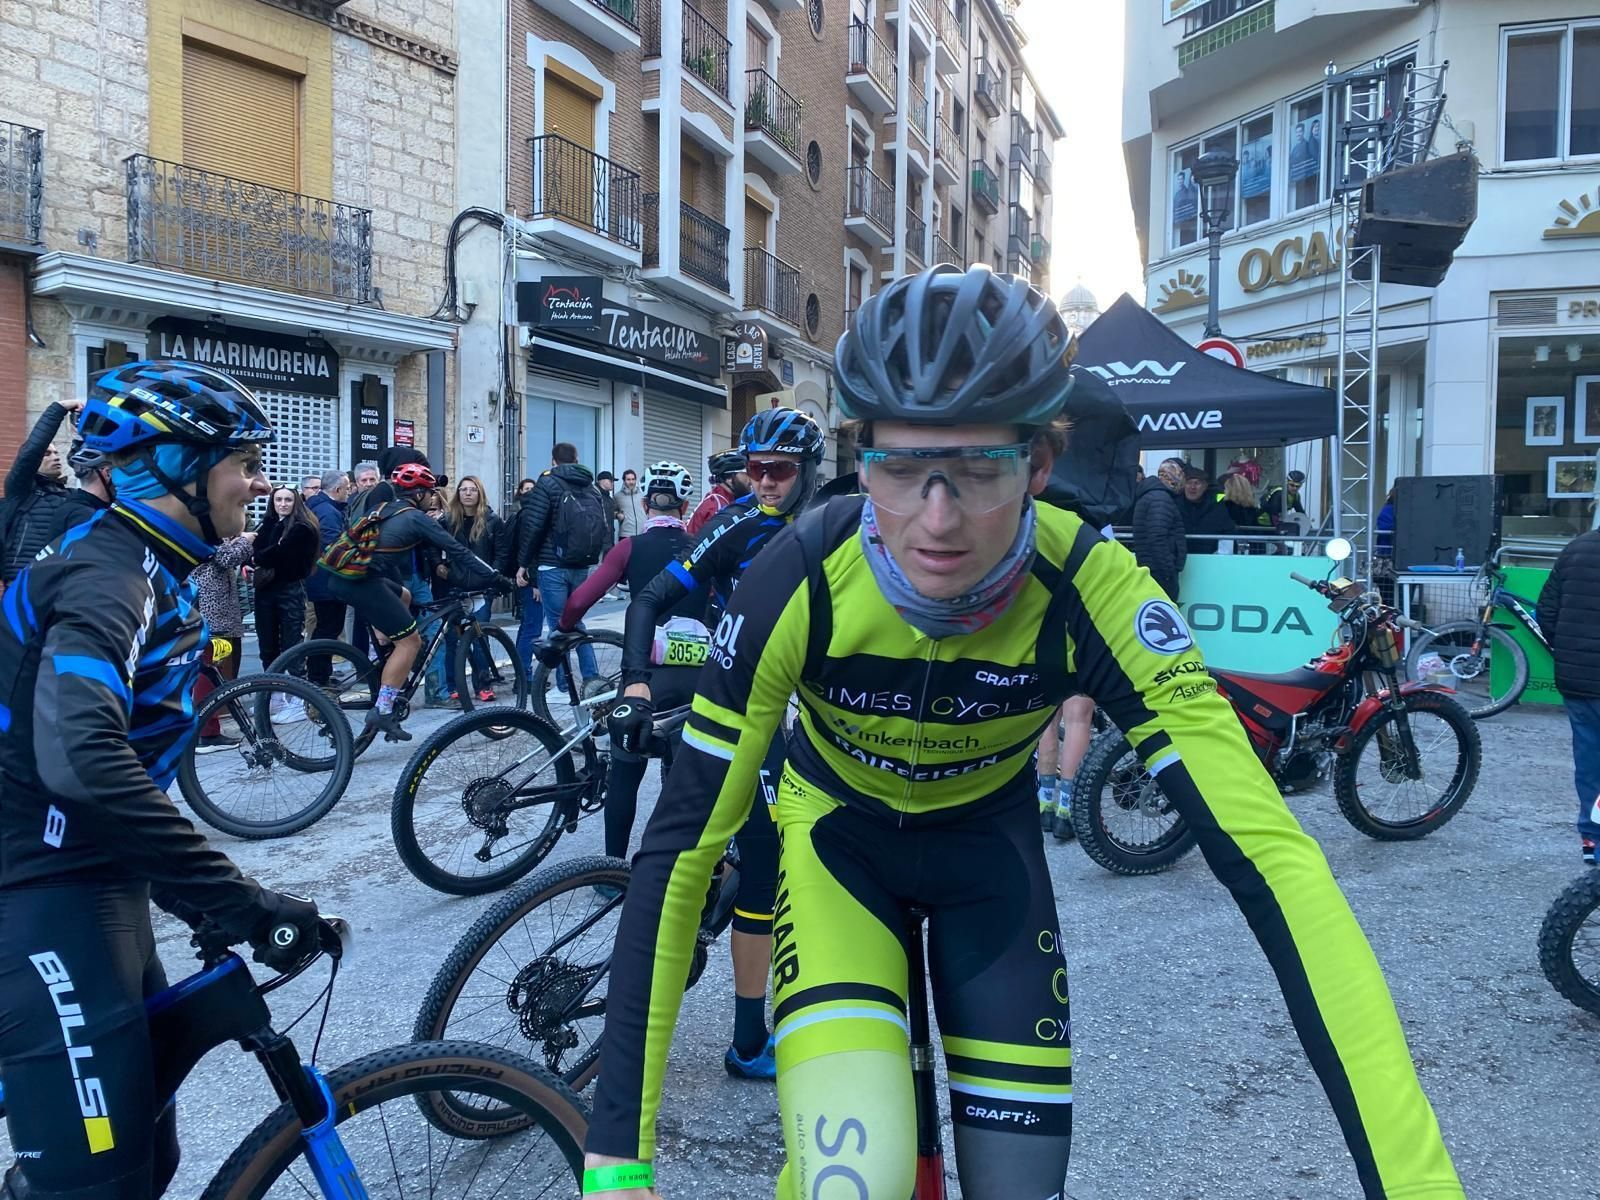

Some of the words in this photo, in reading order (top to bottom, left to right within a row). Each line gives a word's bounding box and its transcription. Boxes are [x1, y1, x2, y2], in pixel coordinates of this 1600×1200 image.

[548, 297, 593, 309] Tentación
[160, 332, 187, 360] LA
[193, 336, 330, 378] MARIMORENA
[752, 342, 763, 369] TARTAS
[130, 387, 218, 436] BULLS
[361, 408, 379, 417] MÚSICA
[228, 429, 272, 440] LAZER
[776, 445, 804, 453] LAZER
[690, 508, 761, 564] BULLS
[1185, 602, 1314, 636] ODA
[669, 641, 706, 664] 305-2
[975, 670, 1029, 687] CRAFT
[28, 950, 109, 1118] BULLS
[965, 1105, 1024, 1123] CRAFT
